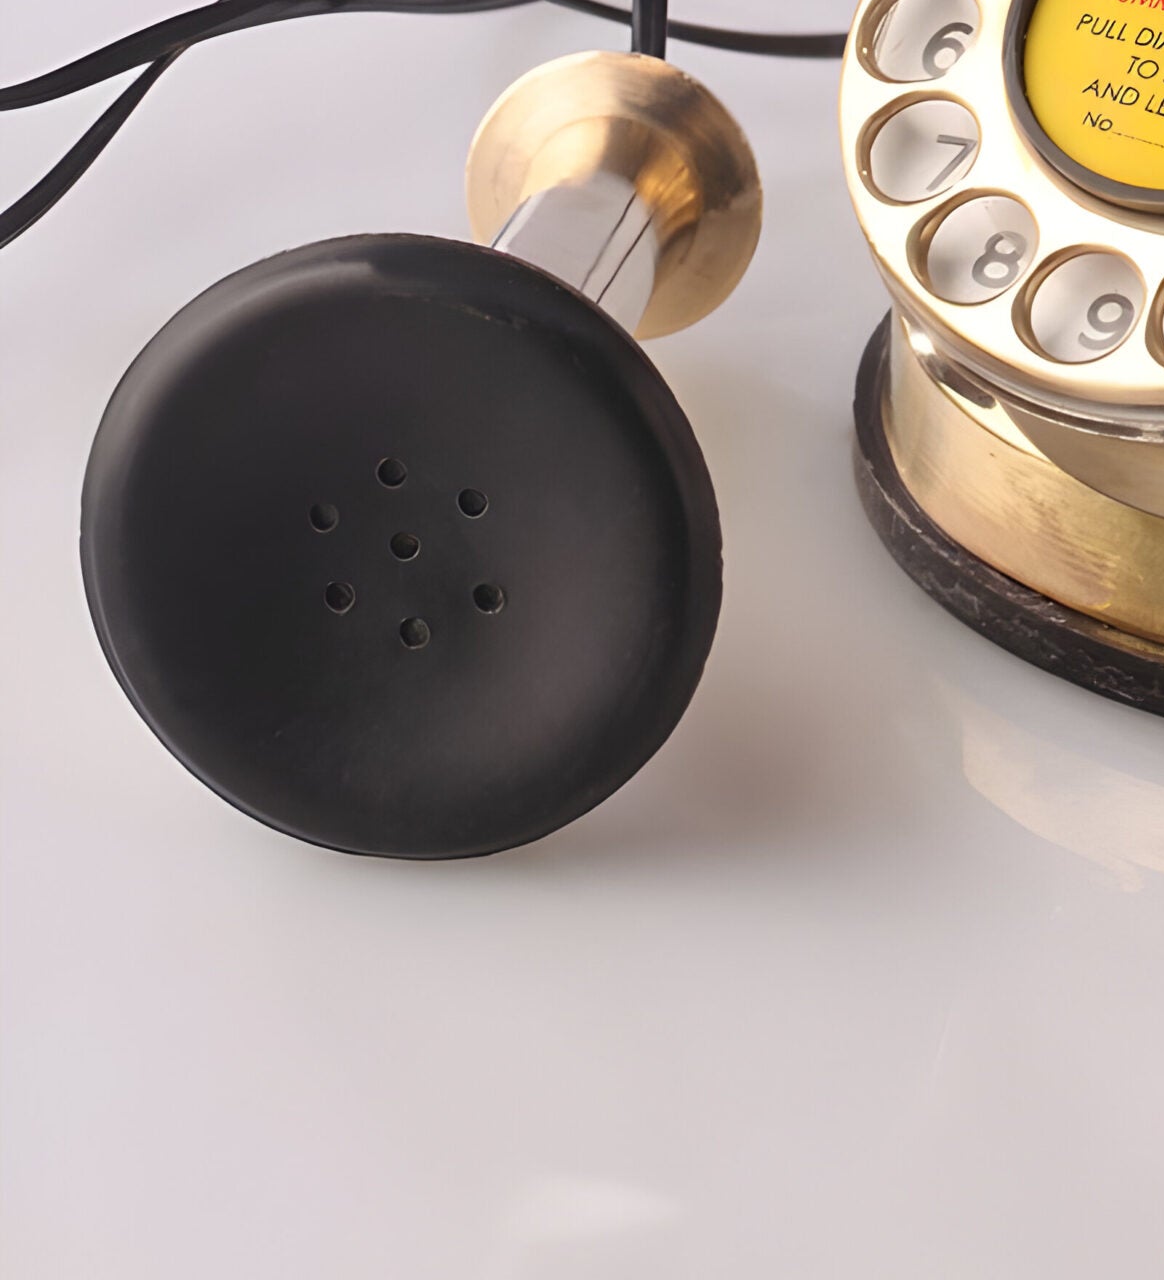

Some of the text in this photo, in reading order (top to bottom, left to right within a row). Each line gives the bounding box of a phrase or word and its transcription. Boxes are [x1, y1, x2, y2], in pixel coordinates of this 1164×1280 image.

[922, 22, 974, 78] 6
[1075, 13, 1127, 43] PULL
[1081, 78, 1138, 108] AND
[1126, 55, 1158, 80] TO
[925, 134, 978, 192] 7
[971, 230, 1028, 289] 8
[1078, 293, 1135, 351] 9
